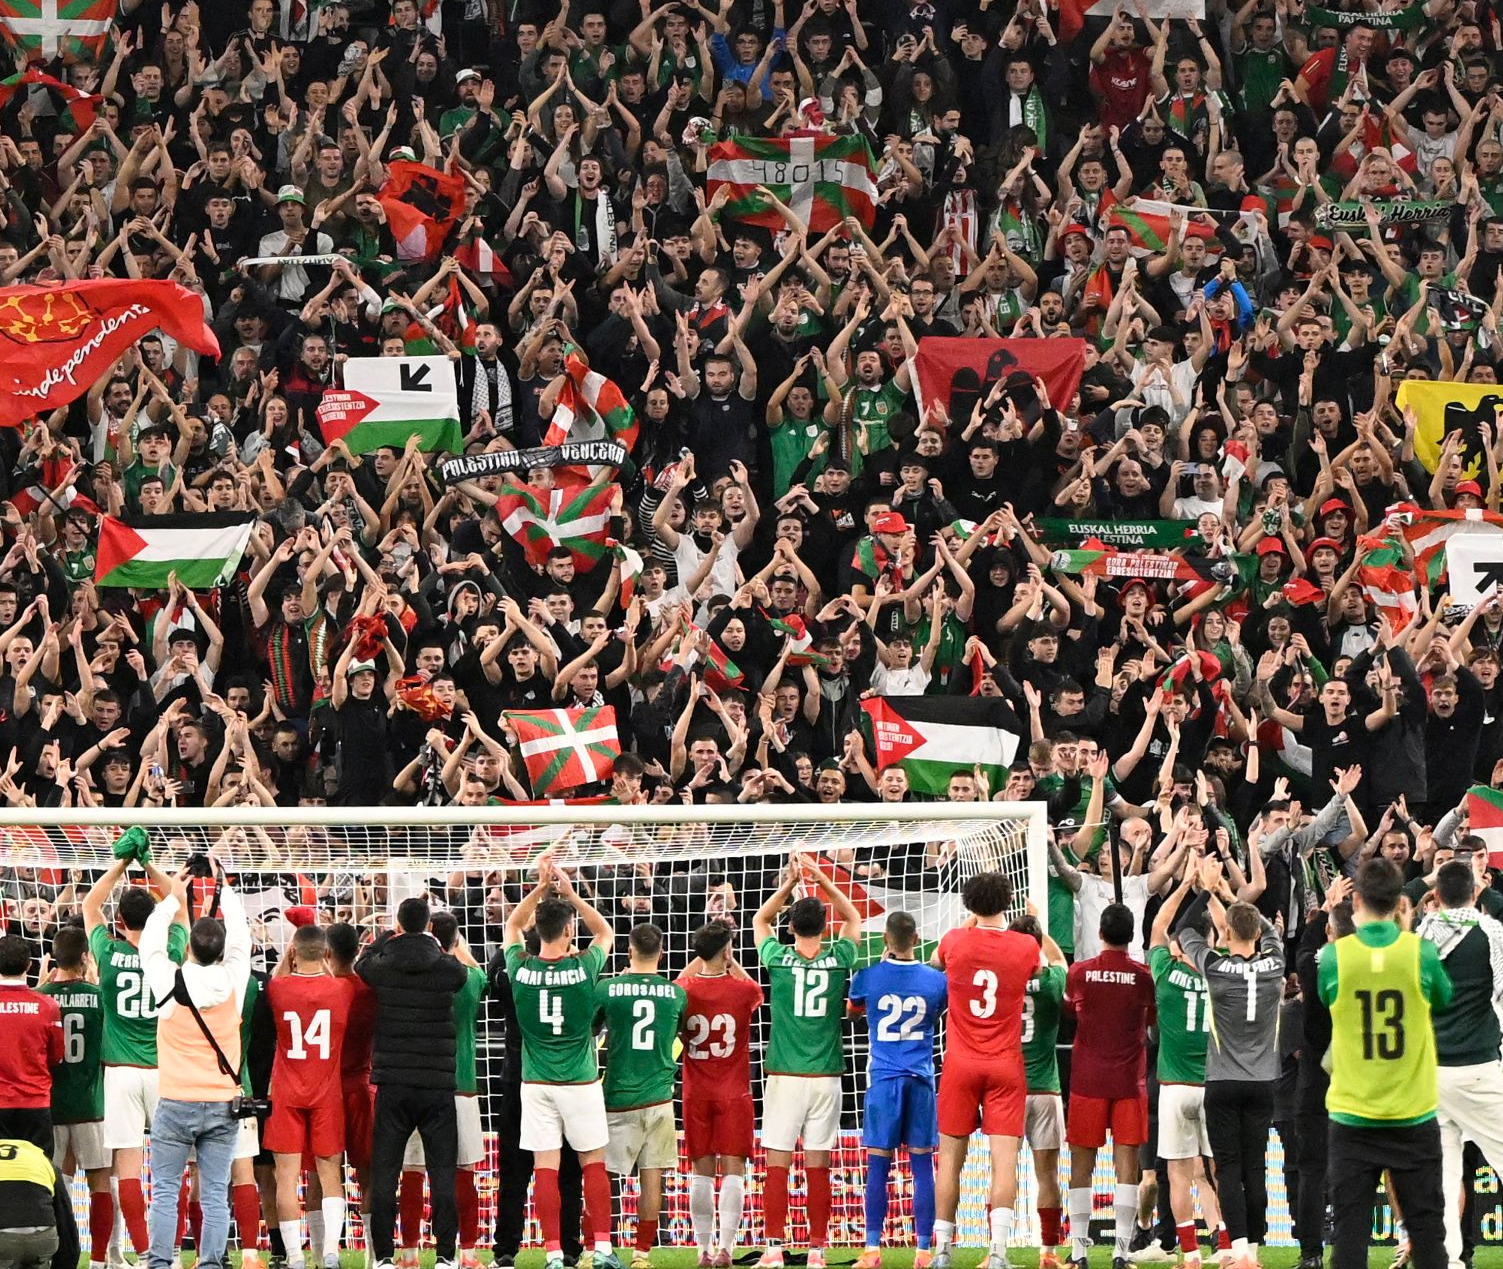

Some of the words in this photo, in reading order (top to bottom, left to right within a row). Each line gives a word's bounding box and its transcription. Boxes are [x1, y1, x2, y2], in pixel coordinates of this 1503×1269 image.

[861, 401, 871, 416] 7
[1068, 524, 1114, 535] EUSKAL
[1114, 525, 1158, 536] HERRIA
[608, 982, 677, 999] GOROSABEL
[791, 966, 829, 1018] 12
[969, 968, 999, 1019] 3
[1085, 970, 1136, 985] PALESTINE
[1243, 971, 1257, 1021] 1
[283, 1009, 331, 1060] 14
[539, 988, 565, 1035] 4
[632, 998, 656, 1051] 2
[877, 993, 927, 1042] 22
[1354, 989, 1405, 1061] 13
[686, 1013, 737, 1061] 23
